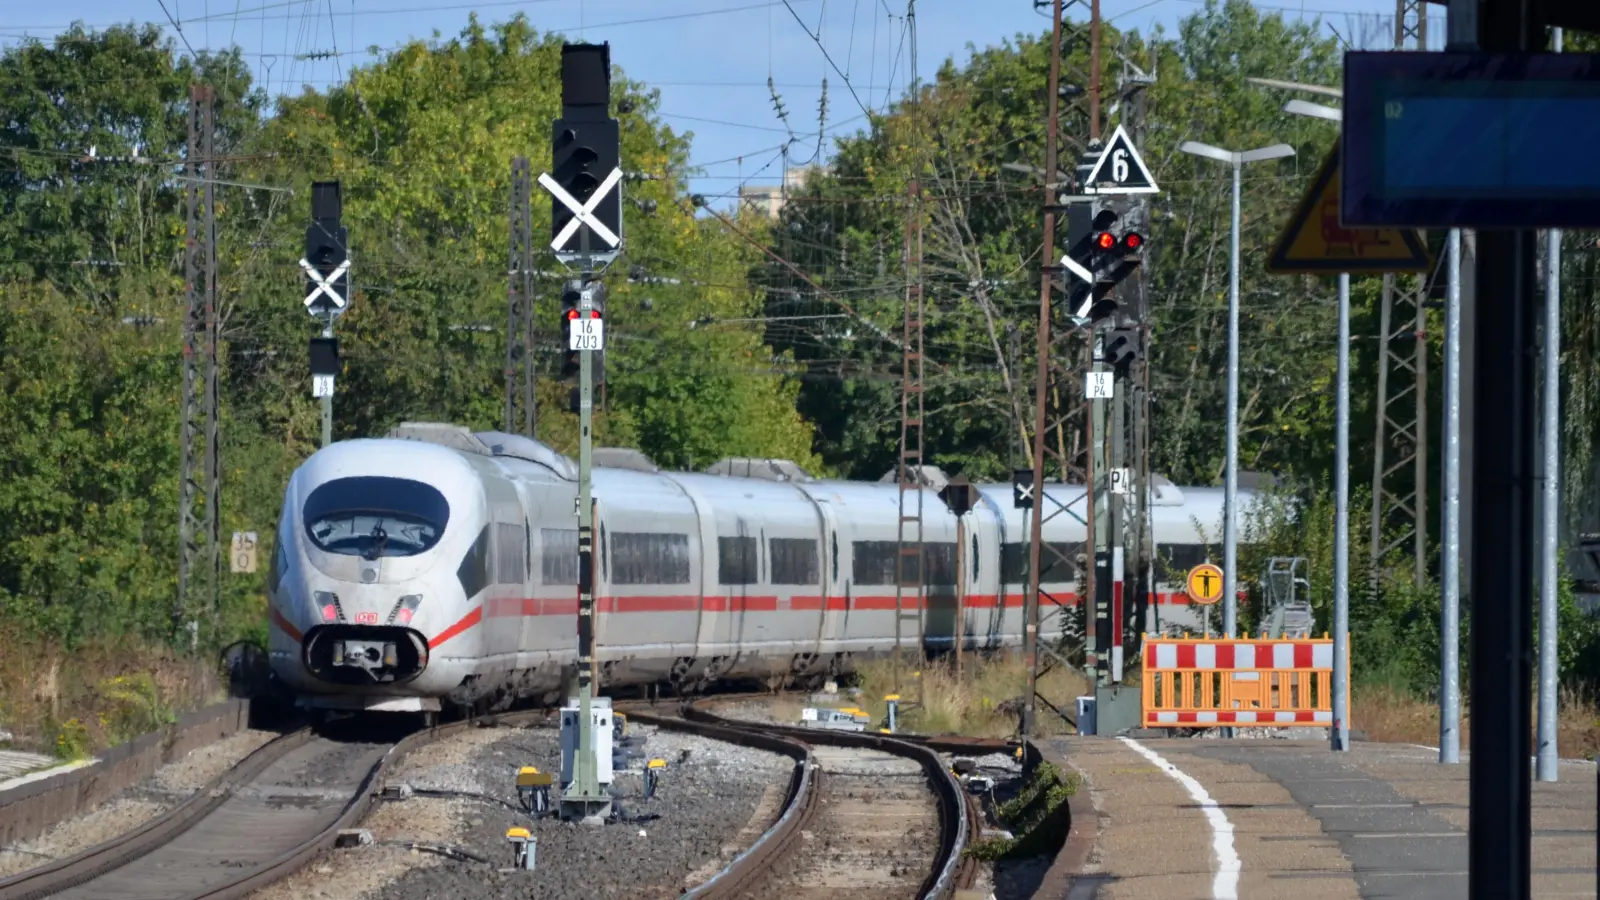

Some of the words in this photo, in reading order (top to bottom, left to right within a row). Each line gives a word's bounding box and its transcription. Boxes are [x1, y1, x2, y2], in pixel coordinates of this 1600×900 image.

[1112, 148, 1129, 183] 6
[580, 320, 593, 334] 16
[575, 335, 598, 349] ZU3
[1094, 373, 1105, 385] 16
[1094, 385, 1106, 397] P4
[1111, 470, 1127, 491] P4
